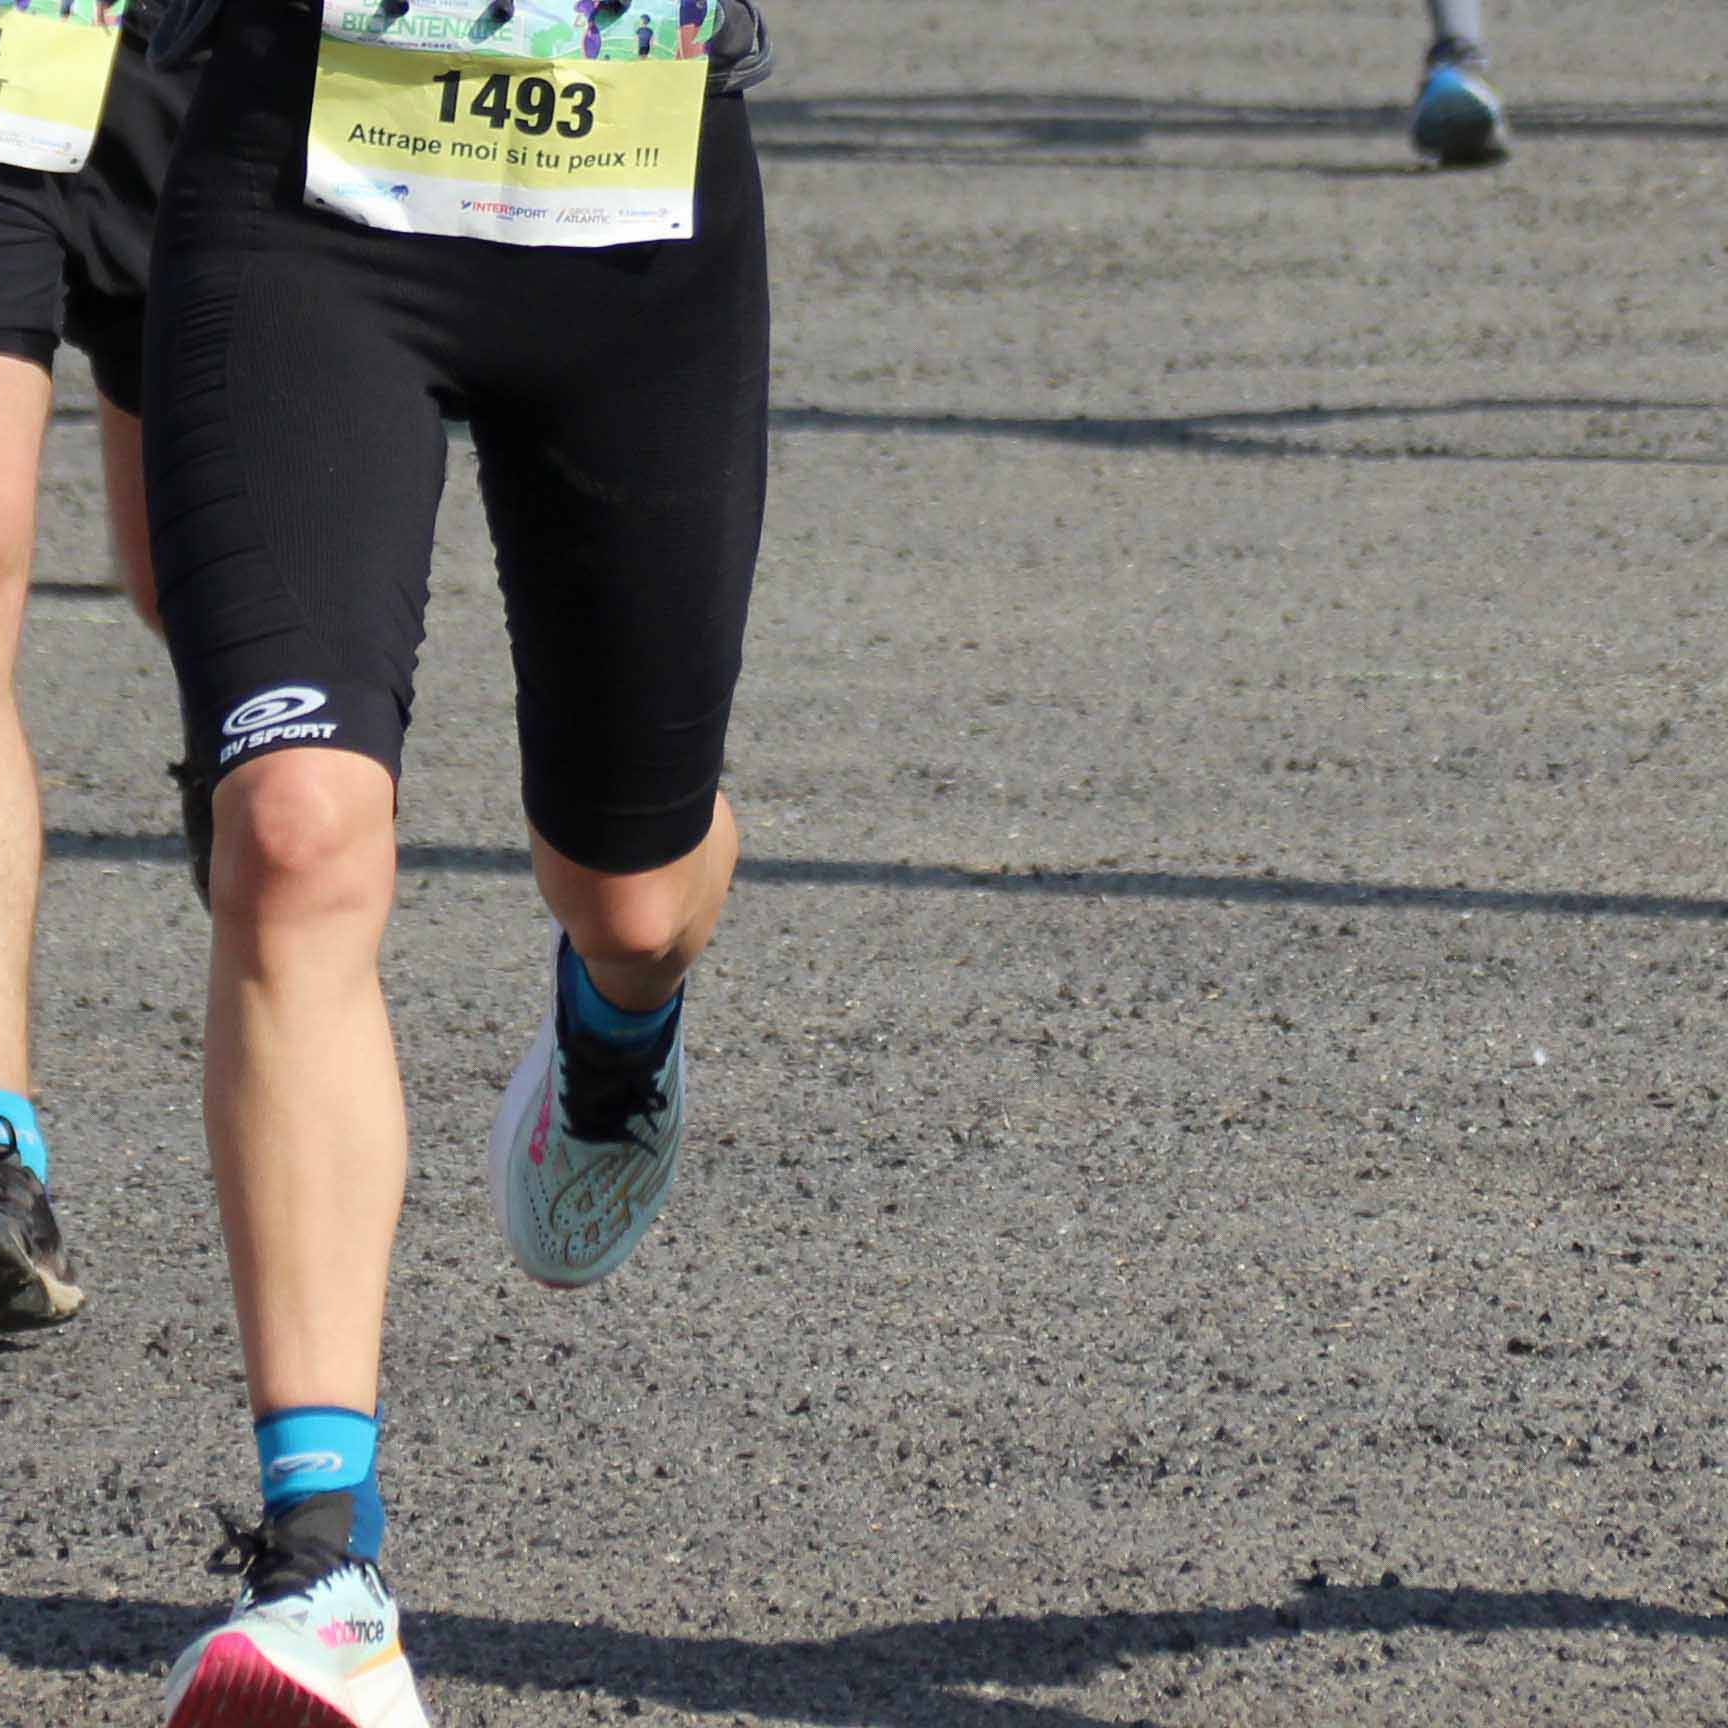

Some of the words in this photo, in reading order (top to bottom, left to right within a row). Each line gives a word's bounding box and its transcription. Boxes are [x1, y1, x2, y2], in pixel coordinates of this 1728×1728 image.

[433, 69, 597, 139] 1493
[347, 123, 442, 155] Attrape
[451, 138, 498, 162] moi
[505, 145, 528, 166] si
[536, 149, 560, 170] tu
[569, 150, 626, 173] peux
[635, 147, 660, 169] !!!
[471, 200, 548, 220] INTERSPORT
[248, 722, 337, 748] SPORT
